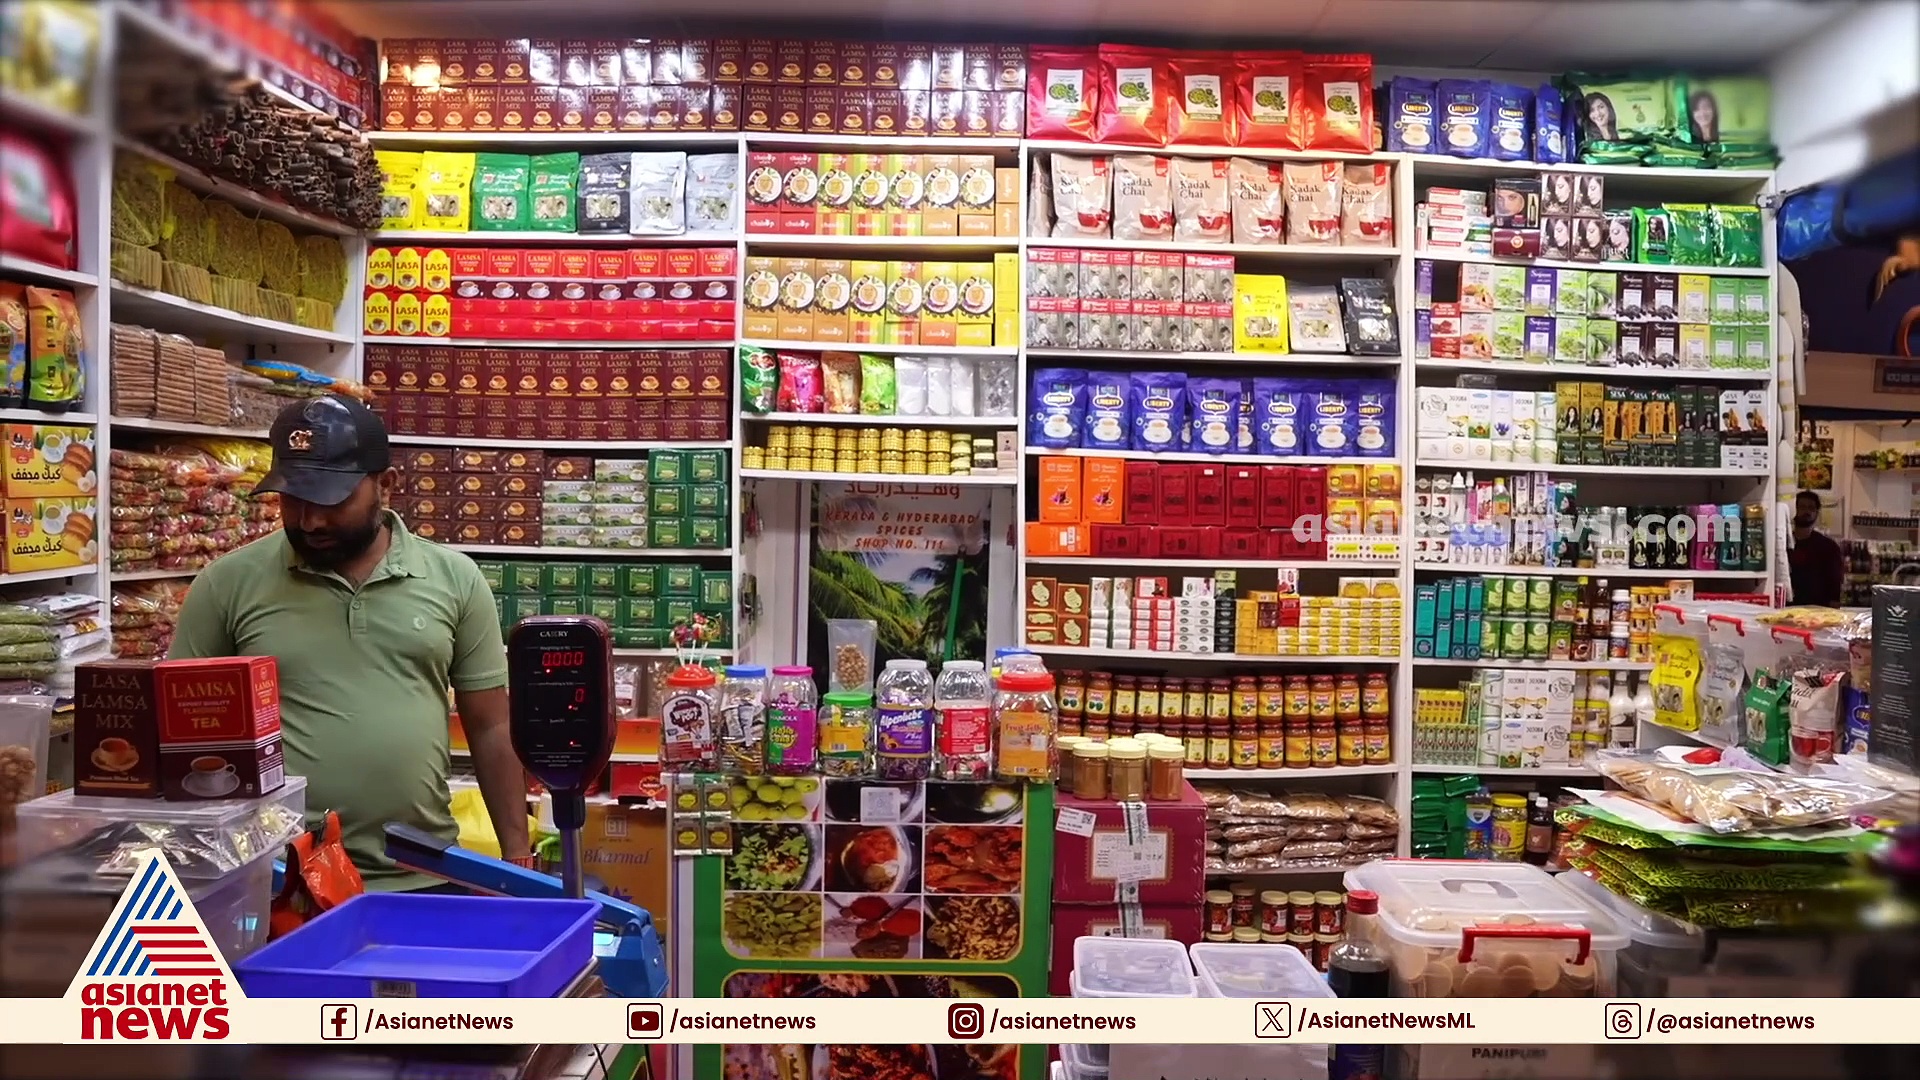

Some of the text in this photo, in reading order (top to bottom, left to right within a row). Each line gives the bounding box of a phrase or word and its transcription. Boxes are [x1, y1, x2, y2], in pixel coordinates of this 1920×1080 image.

[1123, 187, 1145, 196] Chai
[1180, 189, 1202, 198] Chai
[1240, 190, 1262, 200] Chai
[370, 261, 392, 269] LASA
[426, 308, 448, 316] LASA
[11, 468, 39, 483] مجفف
[826, 511, 976, 524] KERALA & HYDERABAD
[876, 525, 923, 535] SPICES
[12, 542, 40, 557] مجفف
[855, 538, 943, 550] SHOP NO. 111
[92, 674, 140, 689] LASA
[255, 680, 274, 692] LAMSA
[172, 681, 235, 698] LAMSA
[576, 689, 584, 702] 0
[82, 694, 147, 710] LAMSA
[96, 714, 134, 728] MIX
[191, 718, 220, 728] TEA
[584, 847, 649, 865] Bharmal
